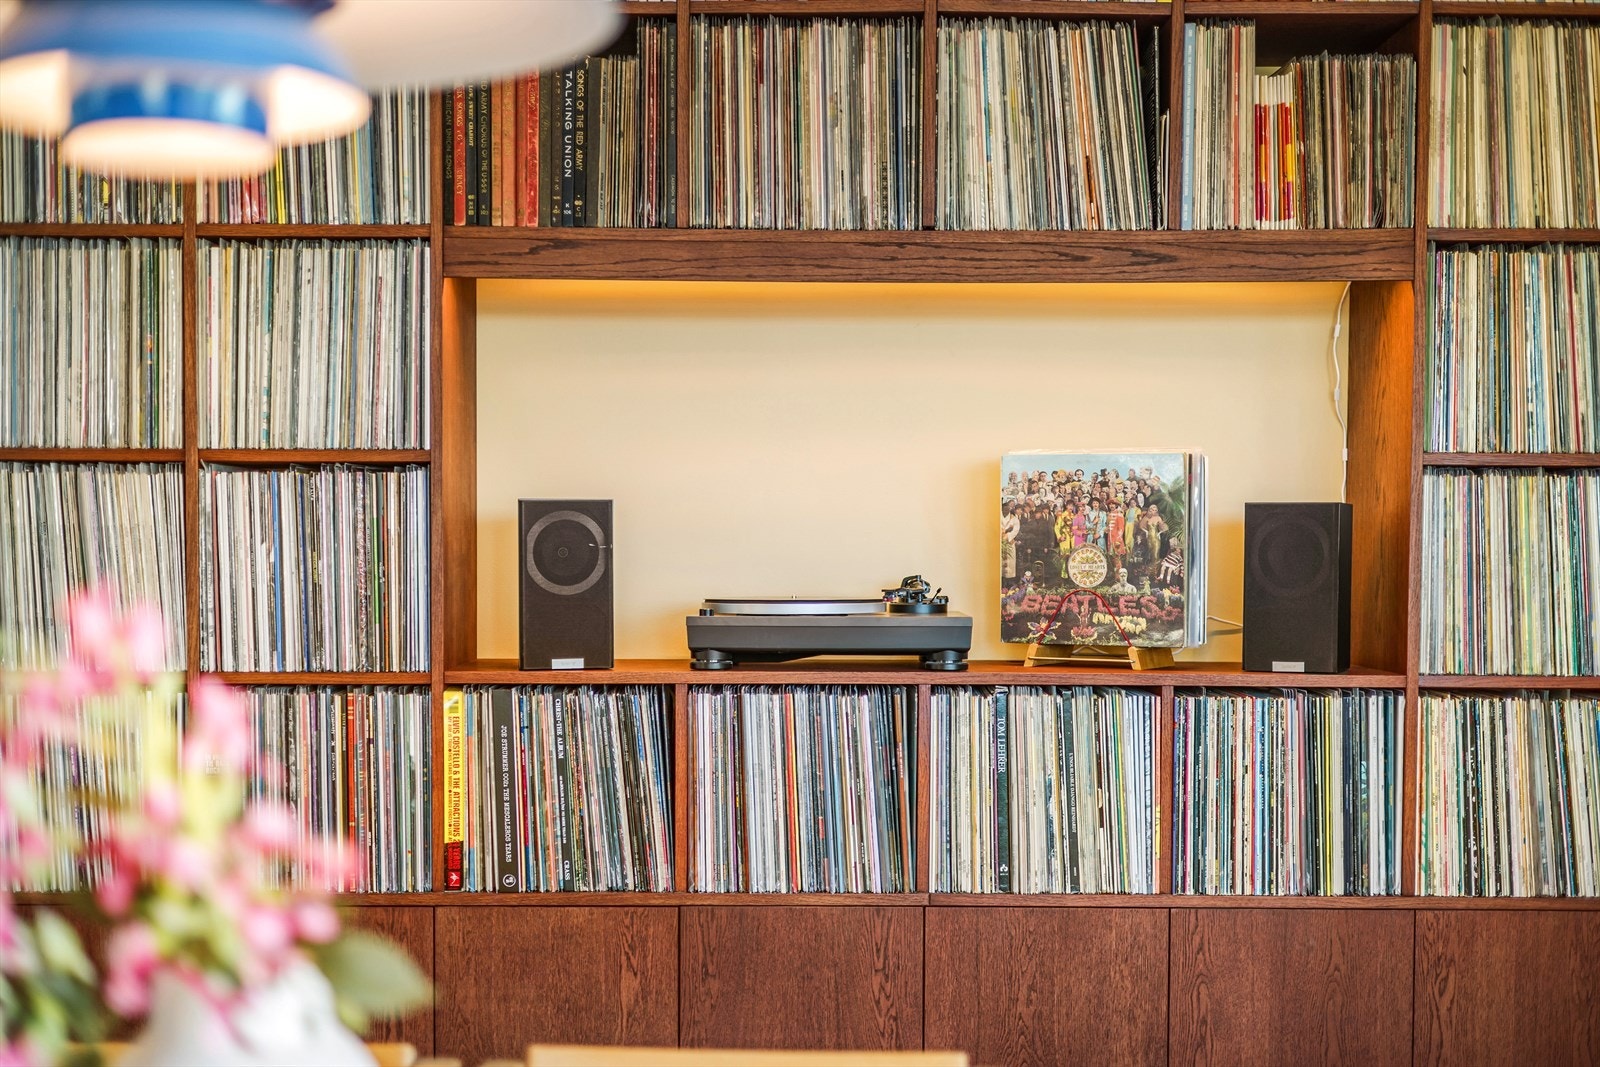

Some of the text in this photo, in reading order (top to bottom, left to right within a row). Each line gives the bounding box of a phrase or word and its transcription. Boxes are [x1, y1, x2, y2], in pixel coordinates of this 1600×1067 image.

[576, 70, 584, 96] SONGS
[576, 100, 584, 111] OF
[564, 71, 573, 178] TALKING UNION
[575, 149, 583, 171] ARMY
[1020, 595, 1159, 616] BEATLES
[556, 737, 564, 759] ALBUM
[998, 739, 1006, 773] LEHRER
[563, 860, 571, 881] CRASS
